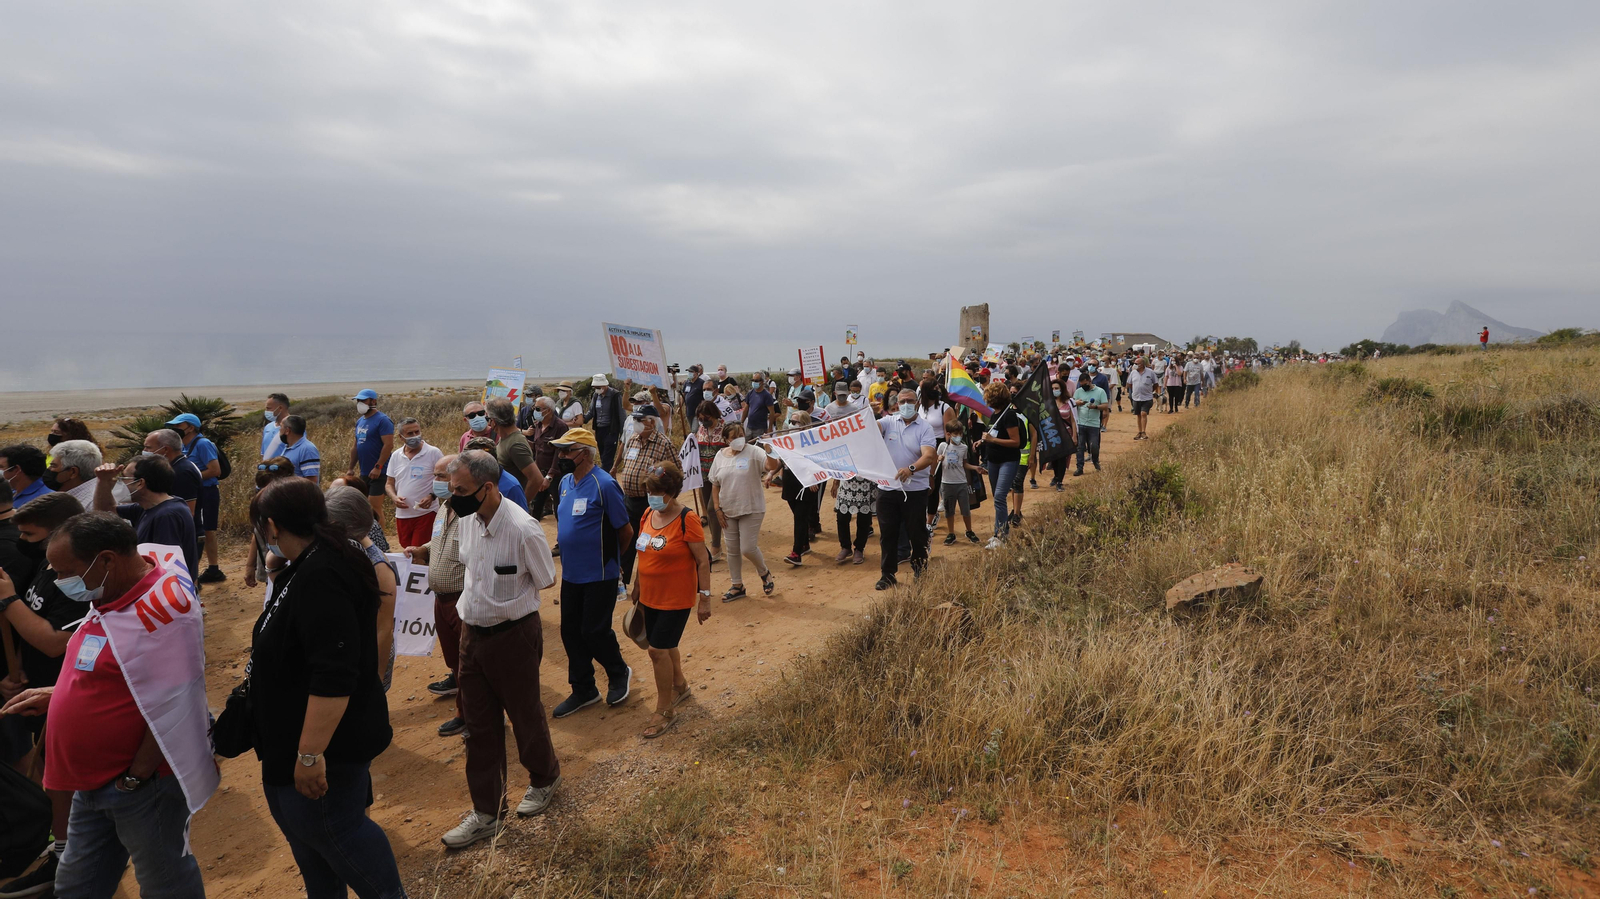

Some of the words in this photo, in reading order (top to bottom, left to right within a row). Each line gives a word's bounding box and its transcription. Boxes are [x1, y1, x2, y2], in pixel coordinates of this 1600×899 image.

[609, 334, 629, 357] NO
[629, 342, 635, 356] A
[633, 344, 644, 357] LA
[617, 356, 660, 375] SUBESTACION
[772, 435, 795, 451] NO
[800, 429, 820, 448] AL
[818, 414, 866, 442] CABLE
[813, 470, 828, 482] NO
[833, 471, 844, 479] LA
[134, 575, 192, 633] NO
